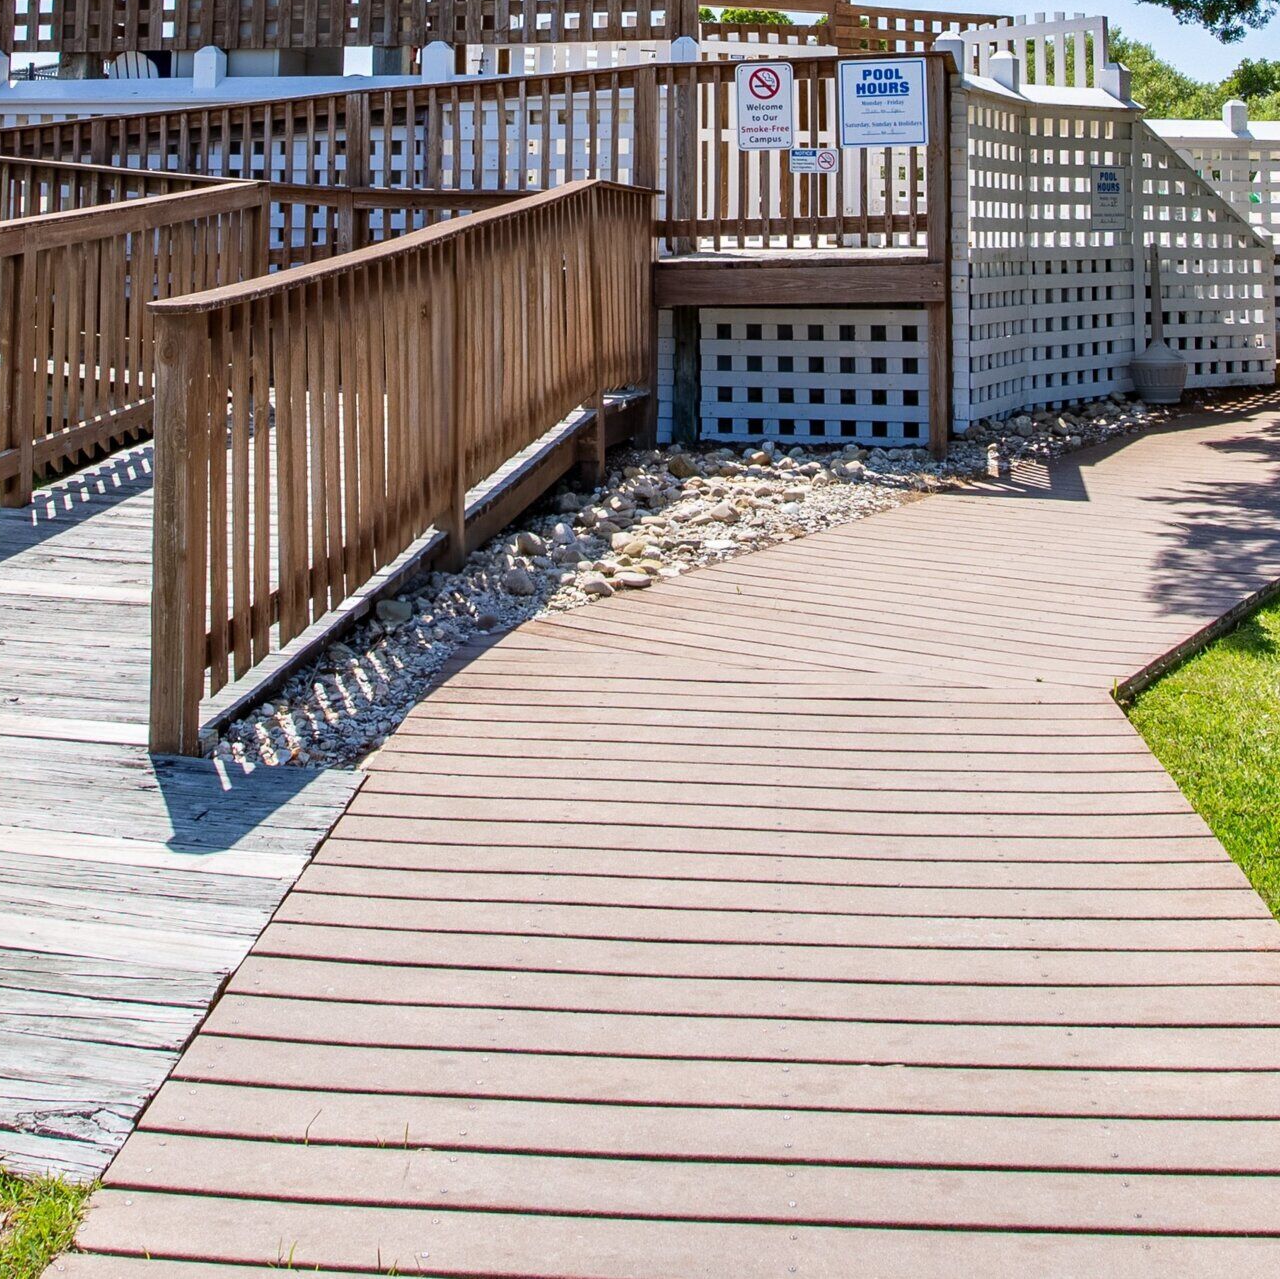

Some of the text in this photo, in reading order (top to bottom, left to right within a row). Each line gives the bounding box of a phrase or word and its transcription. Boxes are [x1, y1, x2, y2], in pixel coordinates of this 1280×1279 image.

[862, 68, 903, 80] POOL
[856, 81, 910, 94] HOURS
[746, 103, 784, 111] Welcome
[762, 114, 778, 122] Our
[741, 124, 790, 133] Smoke-Free
[749, 136, 782, 144] Campus
[1100, 172, 1117, 181] POOL
[1097, 183, 1120, 191] HOURS
